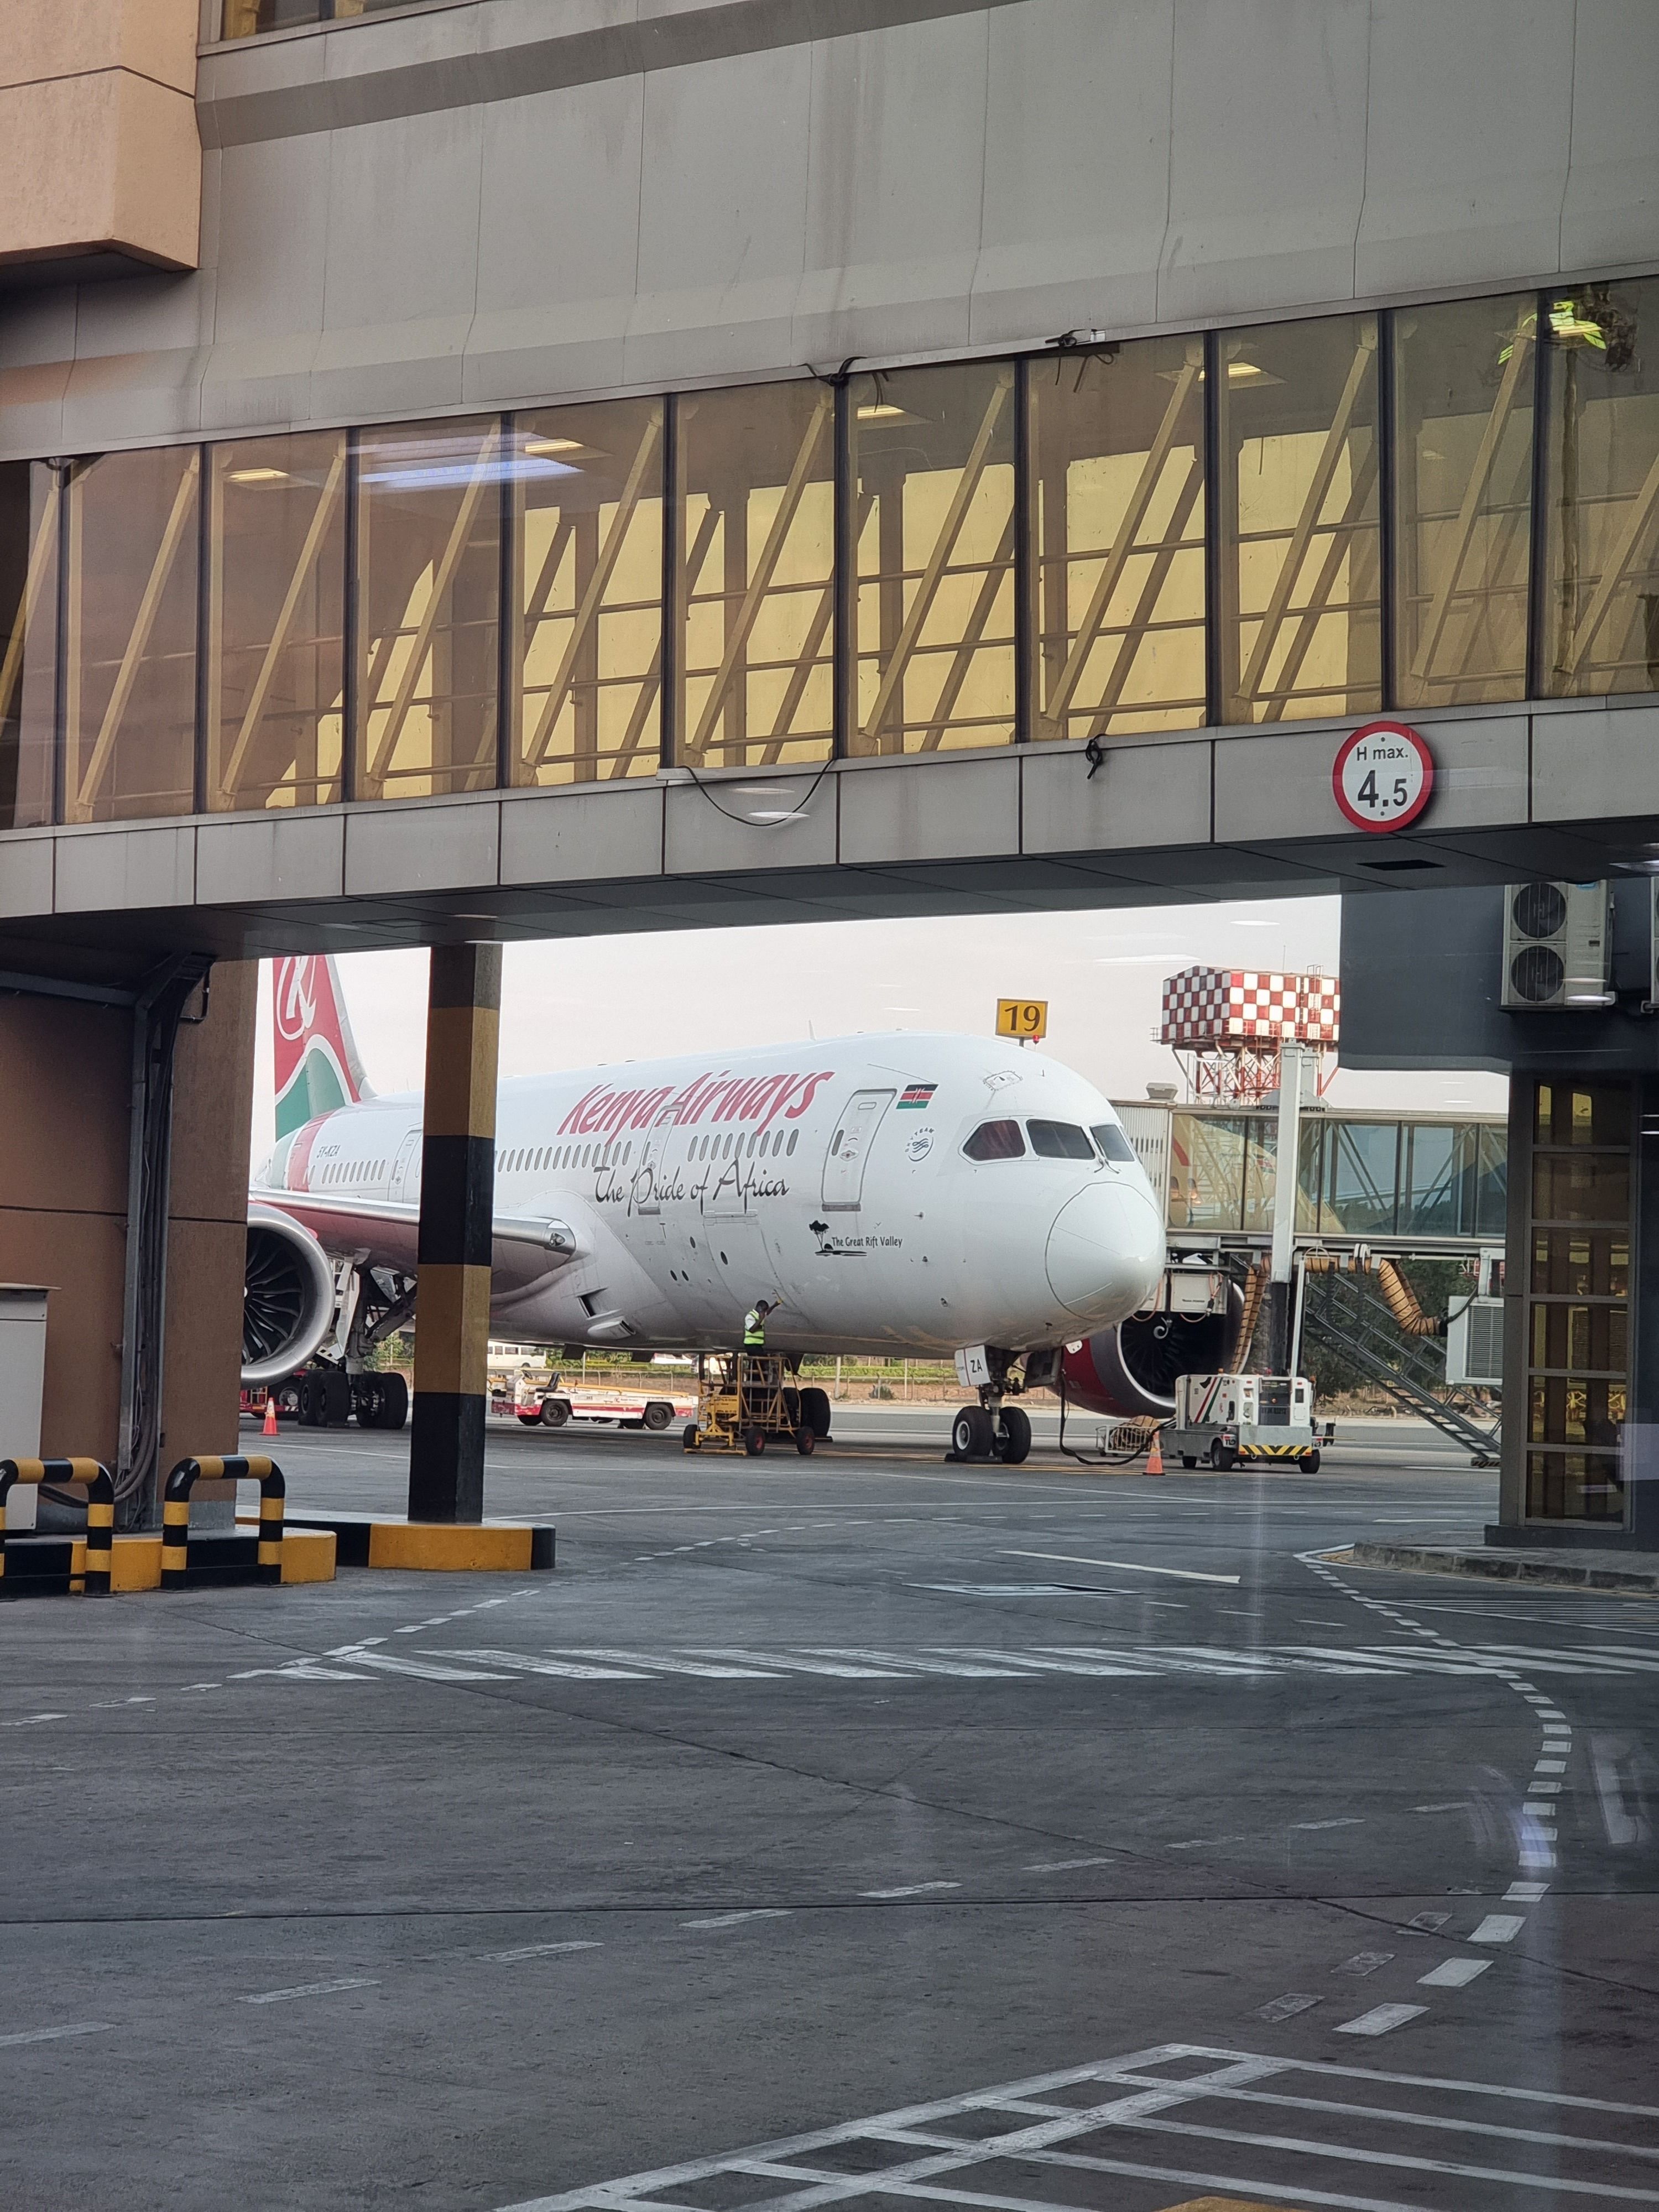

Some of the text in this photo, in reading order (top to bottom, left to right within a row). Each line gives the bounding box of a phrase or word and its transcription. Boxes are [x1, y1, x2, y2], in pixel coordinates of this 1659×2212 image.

[1357, 746, 1408, 761] H max.
[1358, 769, 1407, 808] 4.5
[1004, 1005, 1040, 1032] 19
[556, 1070, 836, 1147] Kenya Airways
[593, 1159, 790, 1217] The Pride of Africa
[832, 1236, 902, 1248] The Great Rift Valley
[970, 1358, 983, 1373] ZA
